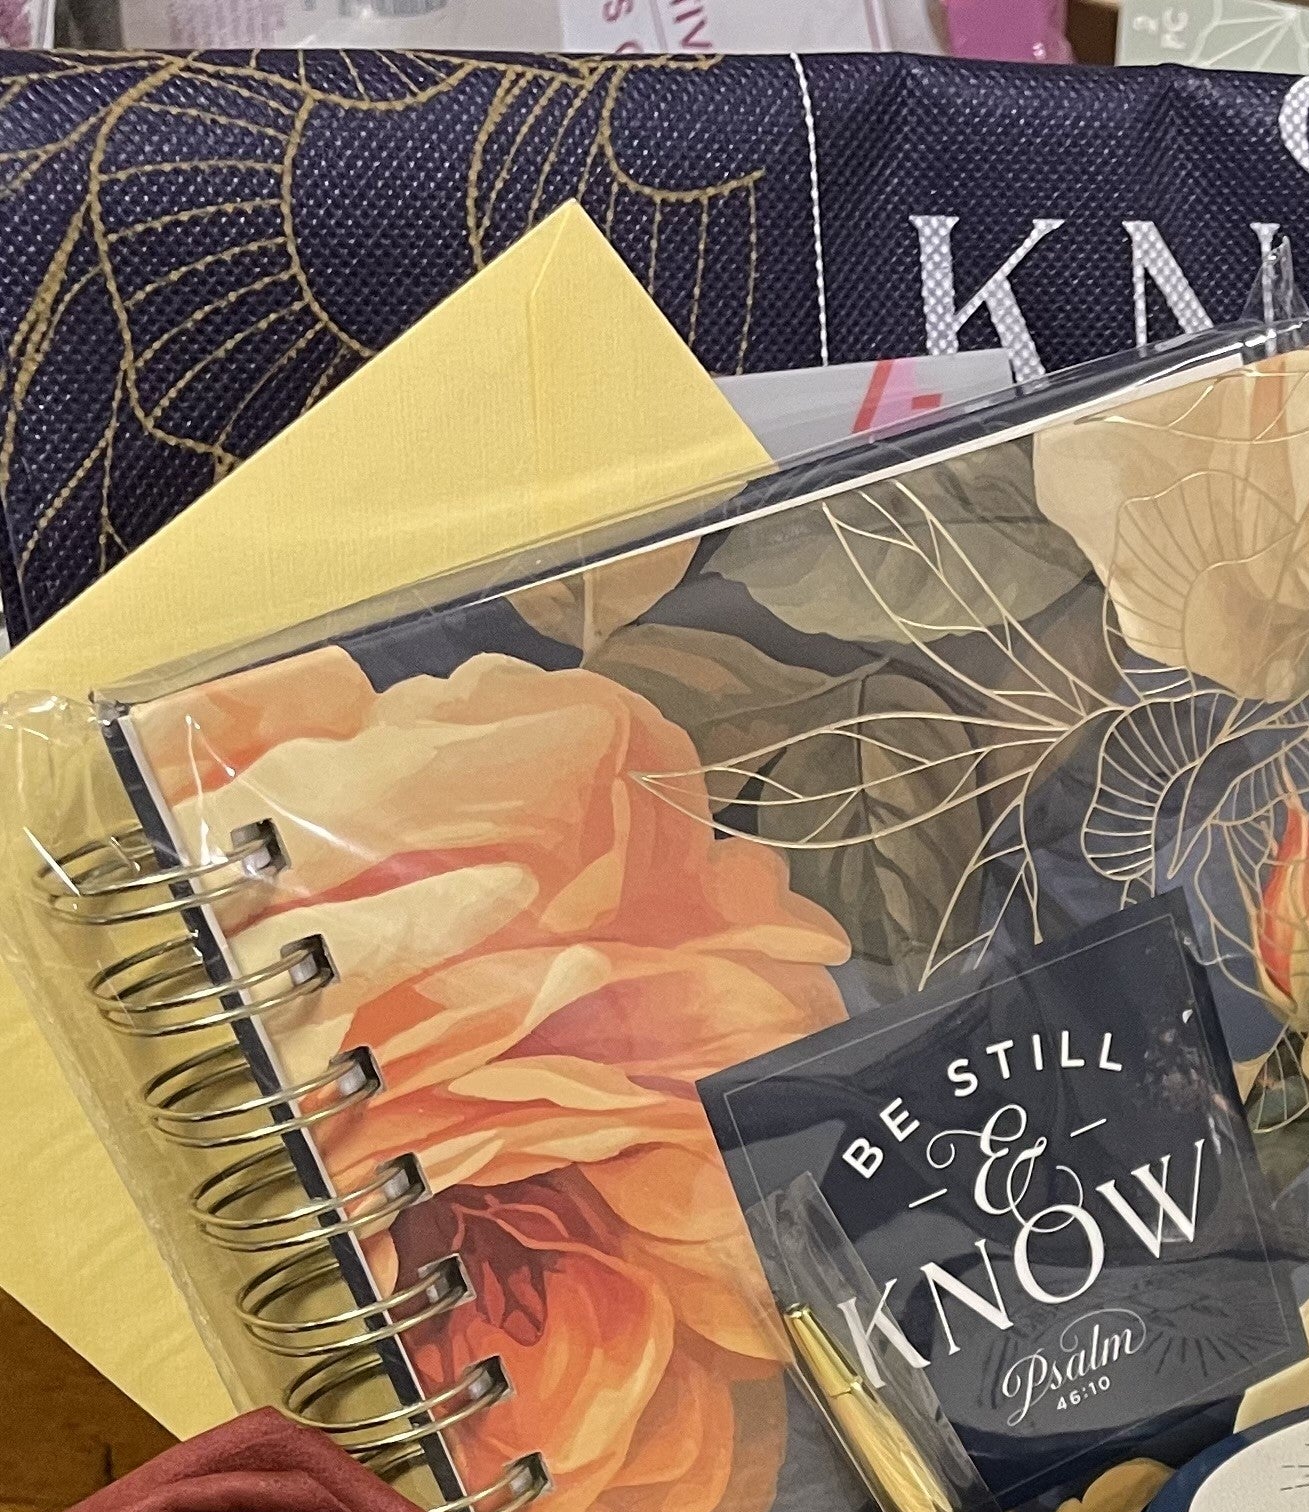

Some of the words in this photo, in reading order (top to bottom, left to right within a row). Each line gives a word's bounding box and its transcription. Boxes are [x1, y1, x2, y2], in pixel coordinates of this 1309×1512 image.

[842, 1097, 920, 1179] BE
[947, 1030, 1123, 1097] STILL
[926, 1104, 1083, 1233] &
[838, 1139, 1205, 1388] KNOW
[1002, 1308, 1147, 1426] Psalm
[1056, 1376, 1110, 1411] 46:10
